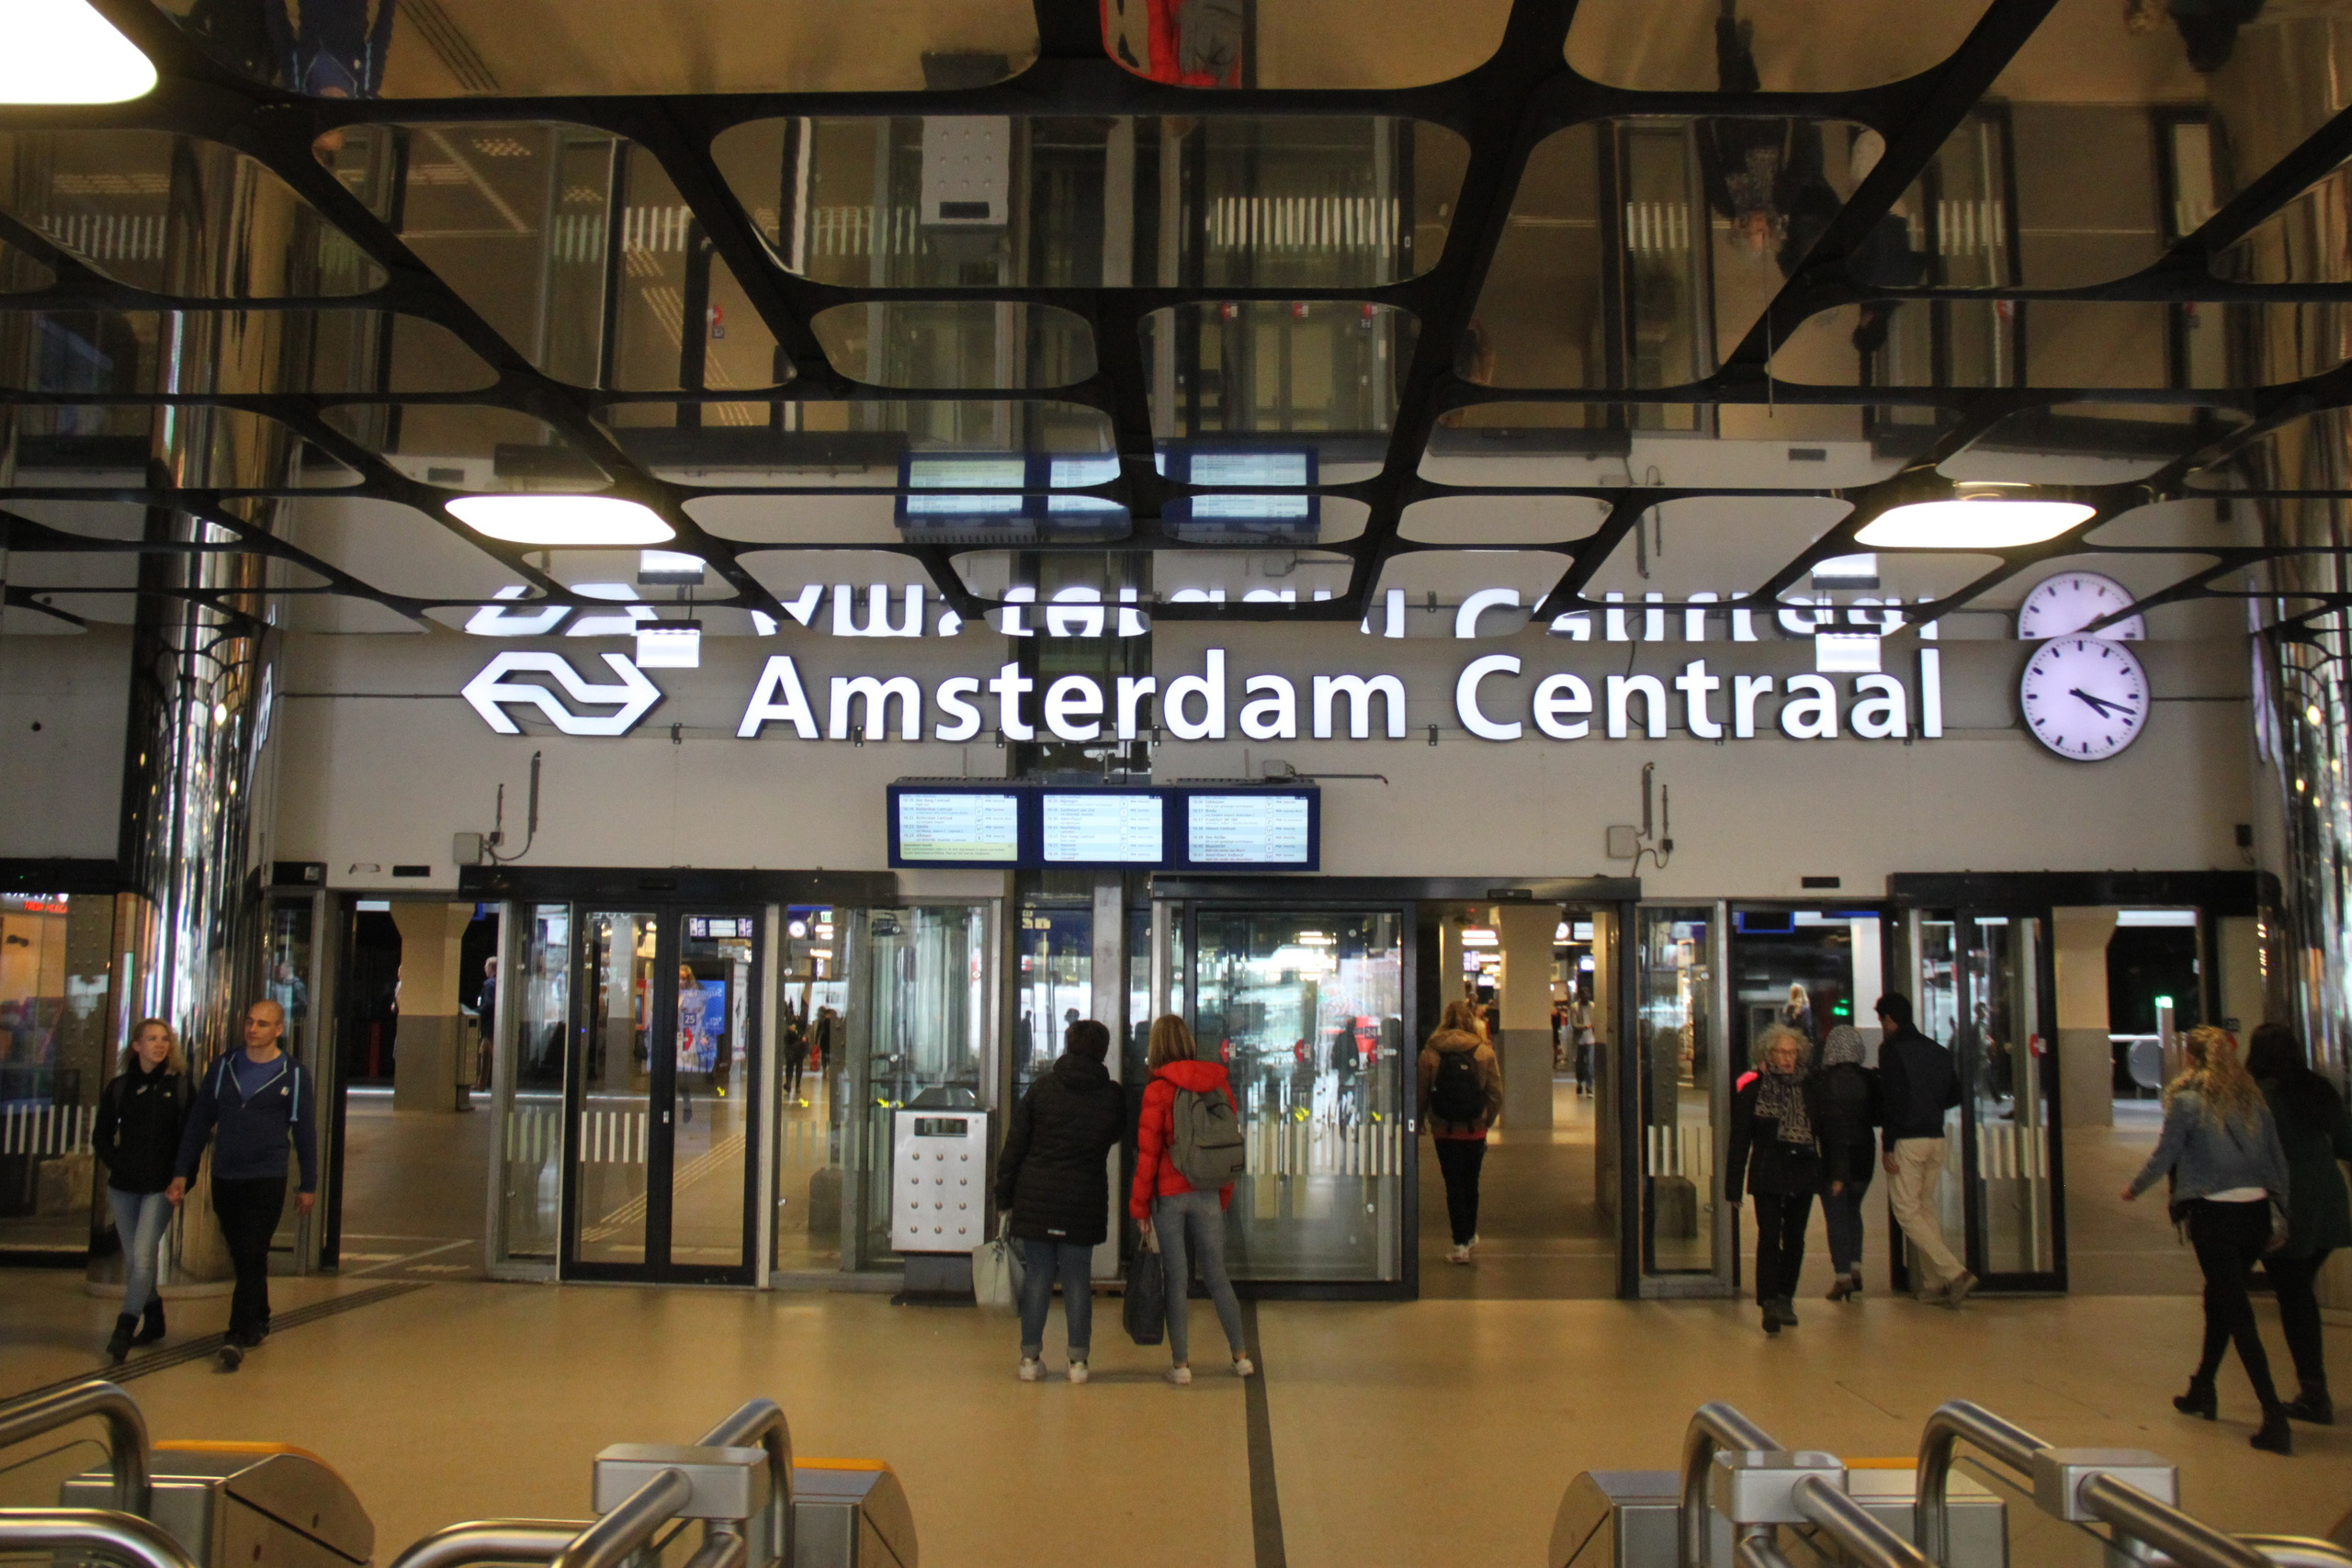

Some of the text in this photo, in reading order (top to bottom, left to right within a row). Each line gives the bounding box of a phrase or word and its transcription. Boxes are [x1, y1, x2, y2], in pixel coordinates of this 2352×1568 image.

[737, 649, 1942, 741] Amsterdam Centraal
[684, 1014, 695, 1024] 25
[1365, 1028, 1377, 1037] 24
